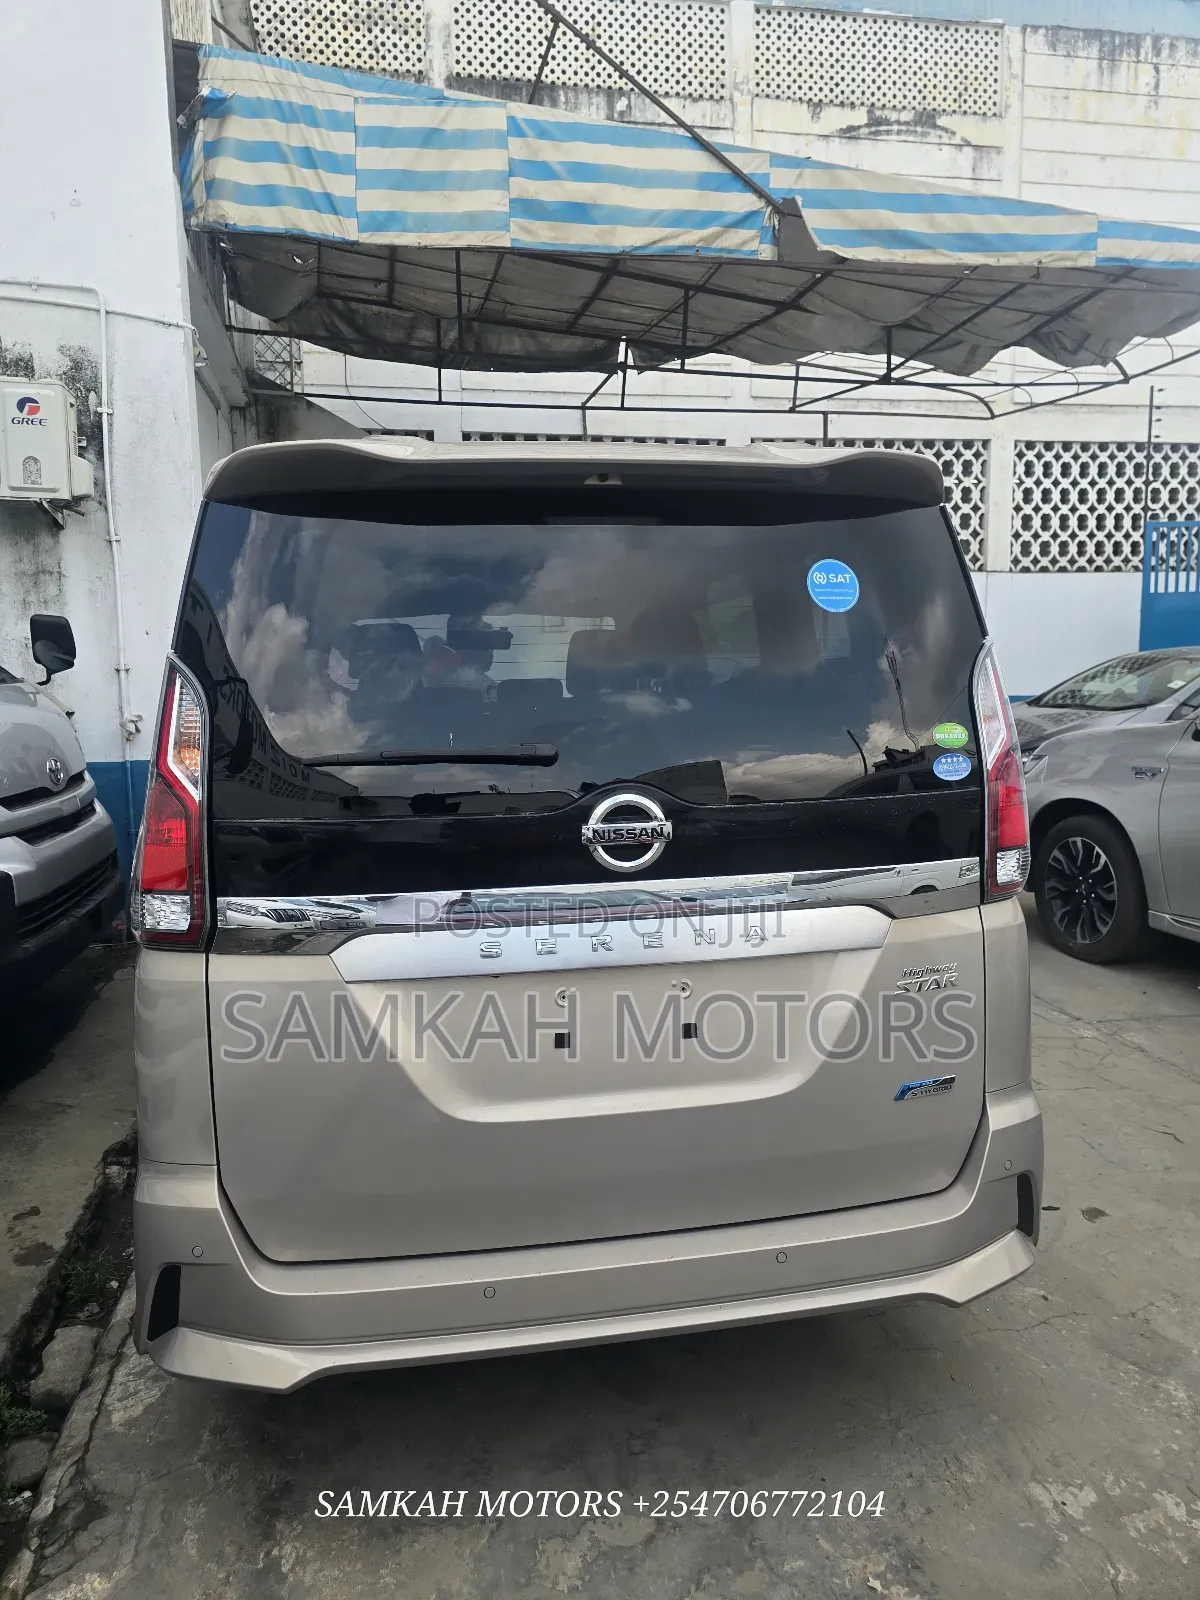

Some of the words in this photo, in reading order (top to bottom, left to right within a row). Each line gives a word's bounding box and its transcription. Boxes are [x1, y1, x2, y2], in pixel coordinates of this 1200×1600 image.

[11, 416, 47, 426] GREE
[828, 573, 851, 584] SAT
[592, 826, 664, 841] NISSAN
[479, 925, 769, 959] SERENA
[902, 963, 958, 979] Highway
[894, 973, 959, 995] STAR
